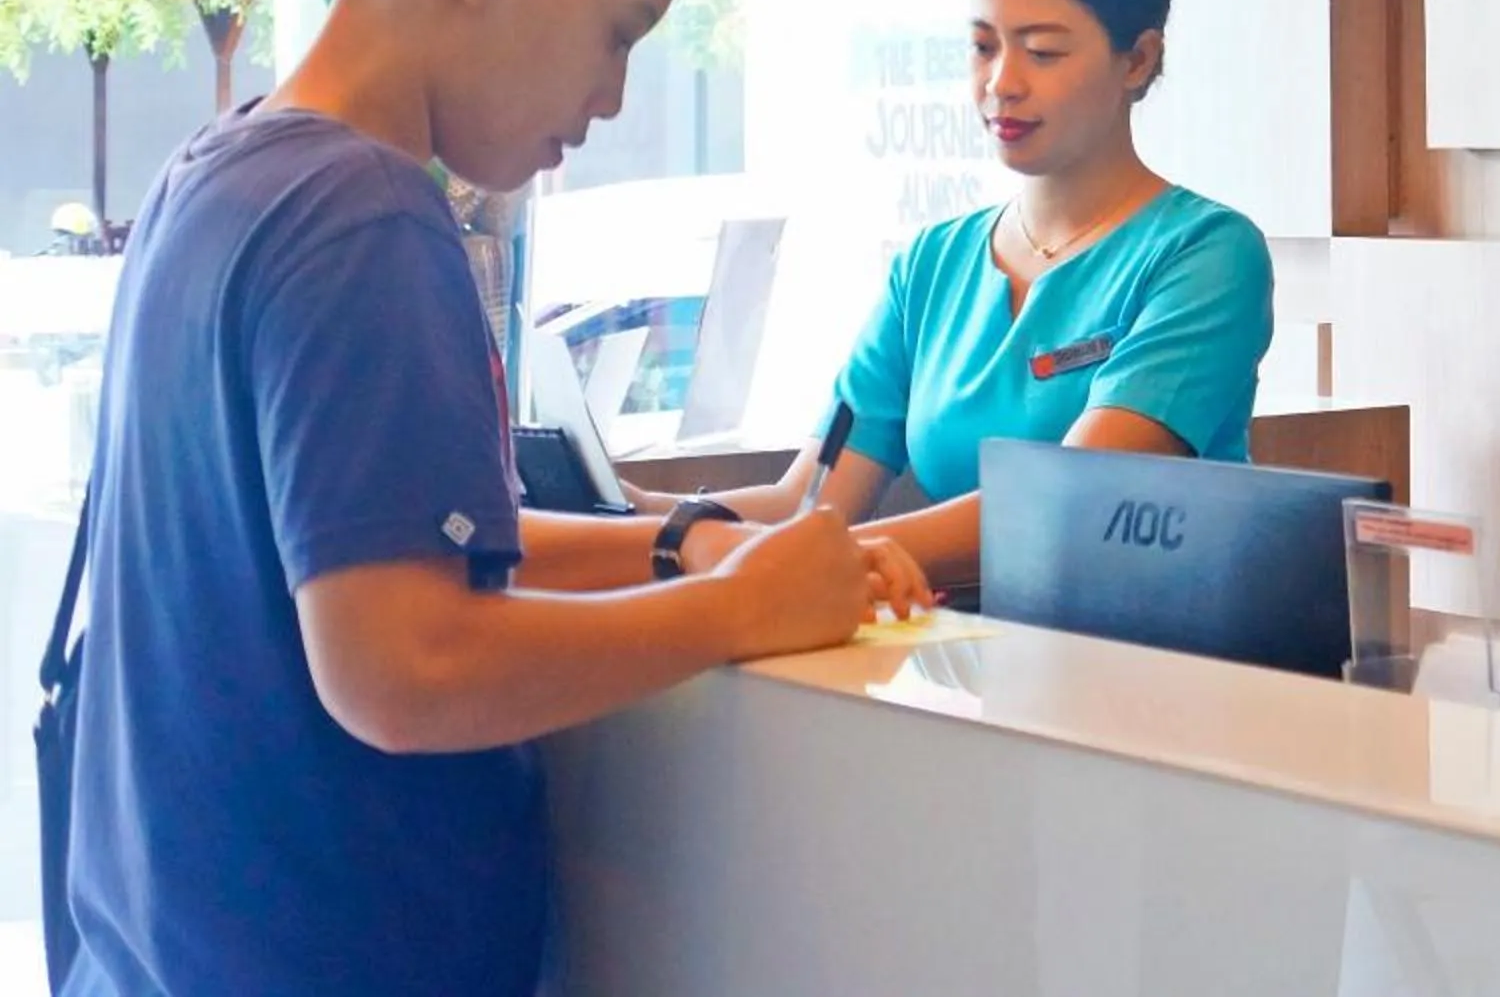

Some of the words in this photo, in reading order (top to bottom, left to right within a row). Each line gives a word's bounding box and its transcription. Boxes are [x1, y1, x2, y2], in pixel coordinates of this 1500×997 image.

[873, 36, 914, 88] THE
[922, 32, 969, 83] BES
[1103, 499, 1187, 551] AOC
